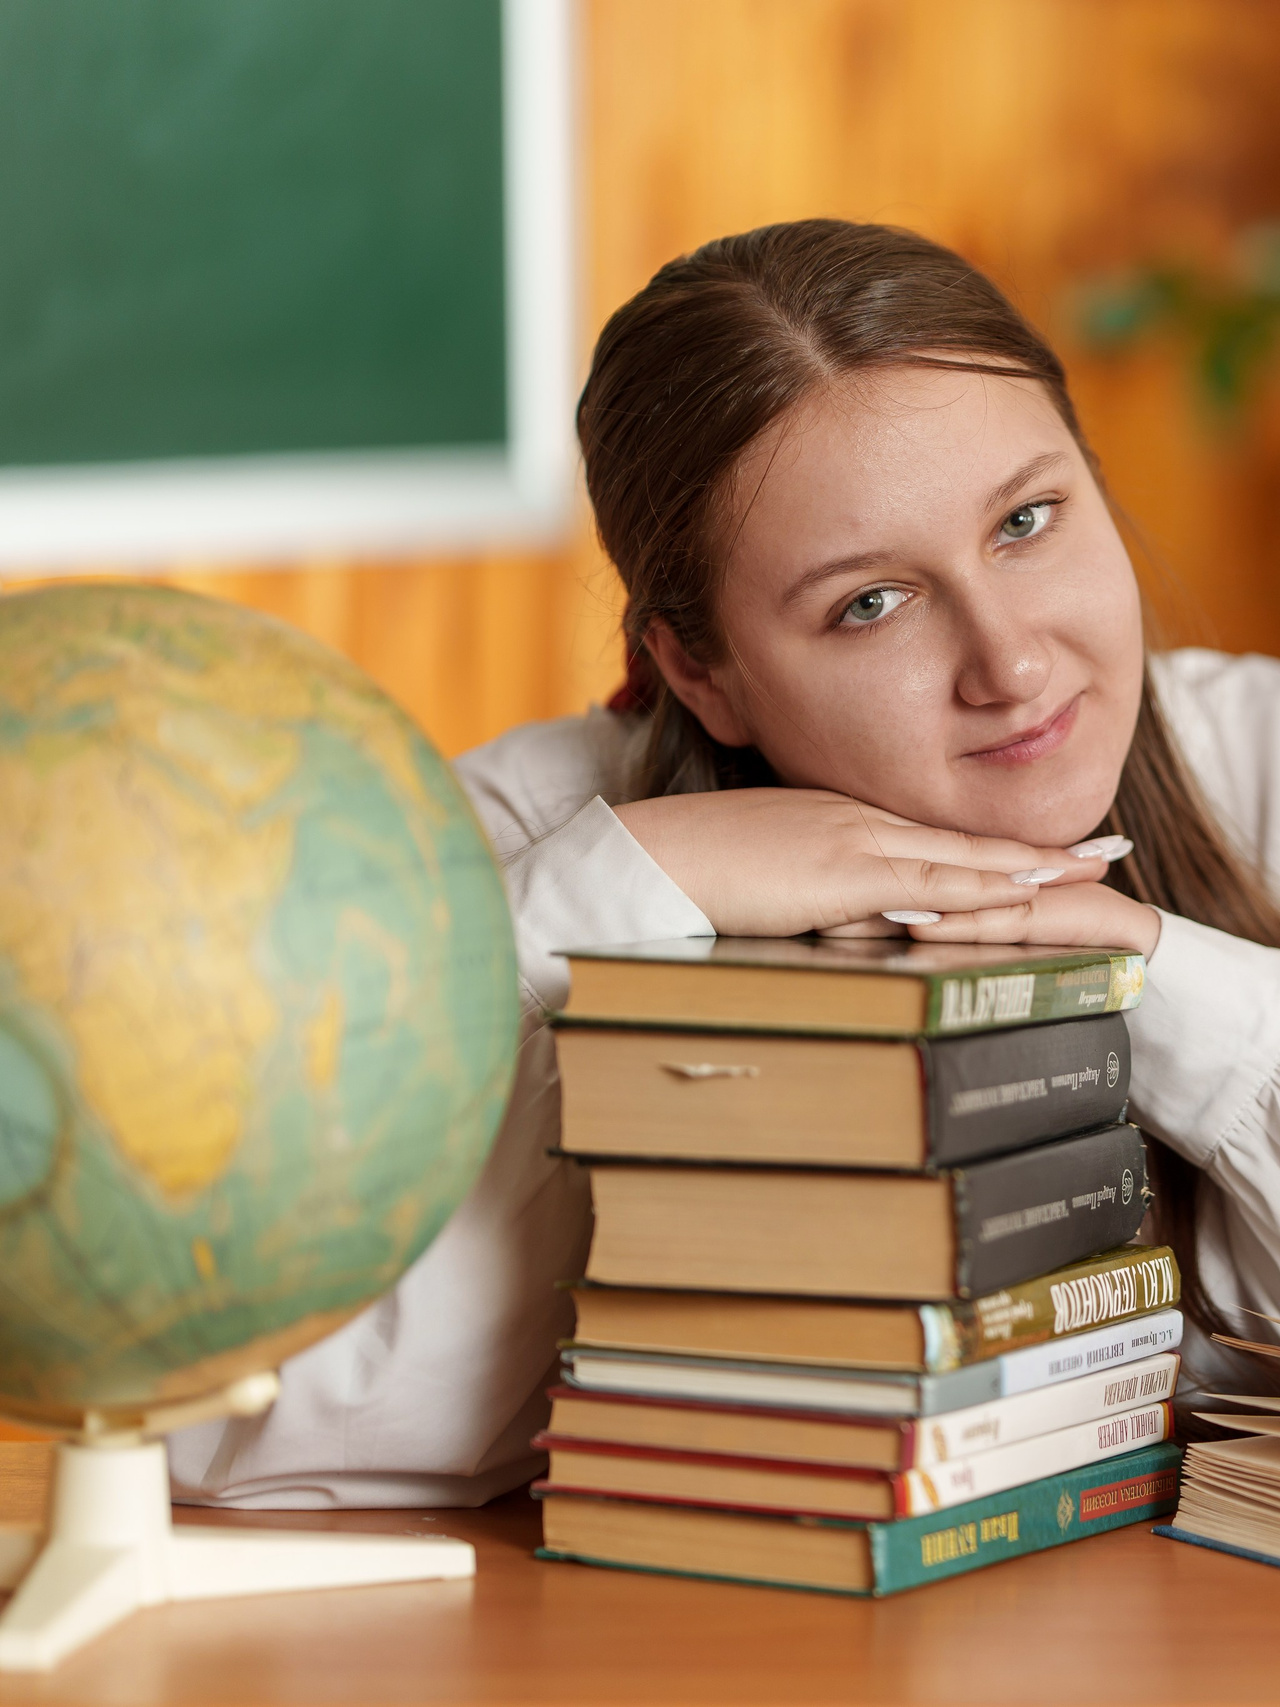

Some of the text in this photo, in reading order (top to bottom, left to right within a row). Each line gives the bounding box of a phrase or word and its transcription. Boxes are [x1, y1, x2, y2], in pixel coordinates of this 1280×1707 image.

[1078, 1067, 1101, 1088] Андрей
[1096, 1185, 1117, 1208] Андрей
[1050, 1265, 1137, 1334] ЛЕРМОНТОВ
[1086, 1342, 1124, 1367] ЕВГЕНИЙ
[1131, 1330, 1158, 1349] Пушкин
[1048, 1354, 1083, 1377] ОНЕГИН
[1103, 1367, 1170, 1407] МАРИНА ЦВЕТАЕВА
[1097, 1409, 1159, 1449] ЛЕОНИД АНДРЕЕВ
[1082, 1475, 1174, 1513] БИБЛИОТЕКА ПОЭЗИИ
[921, 1511, 1020, 1567] Иван БУНИН
